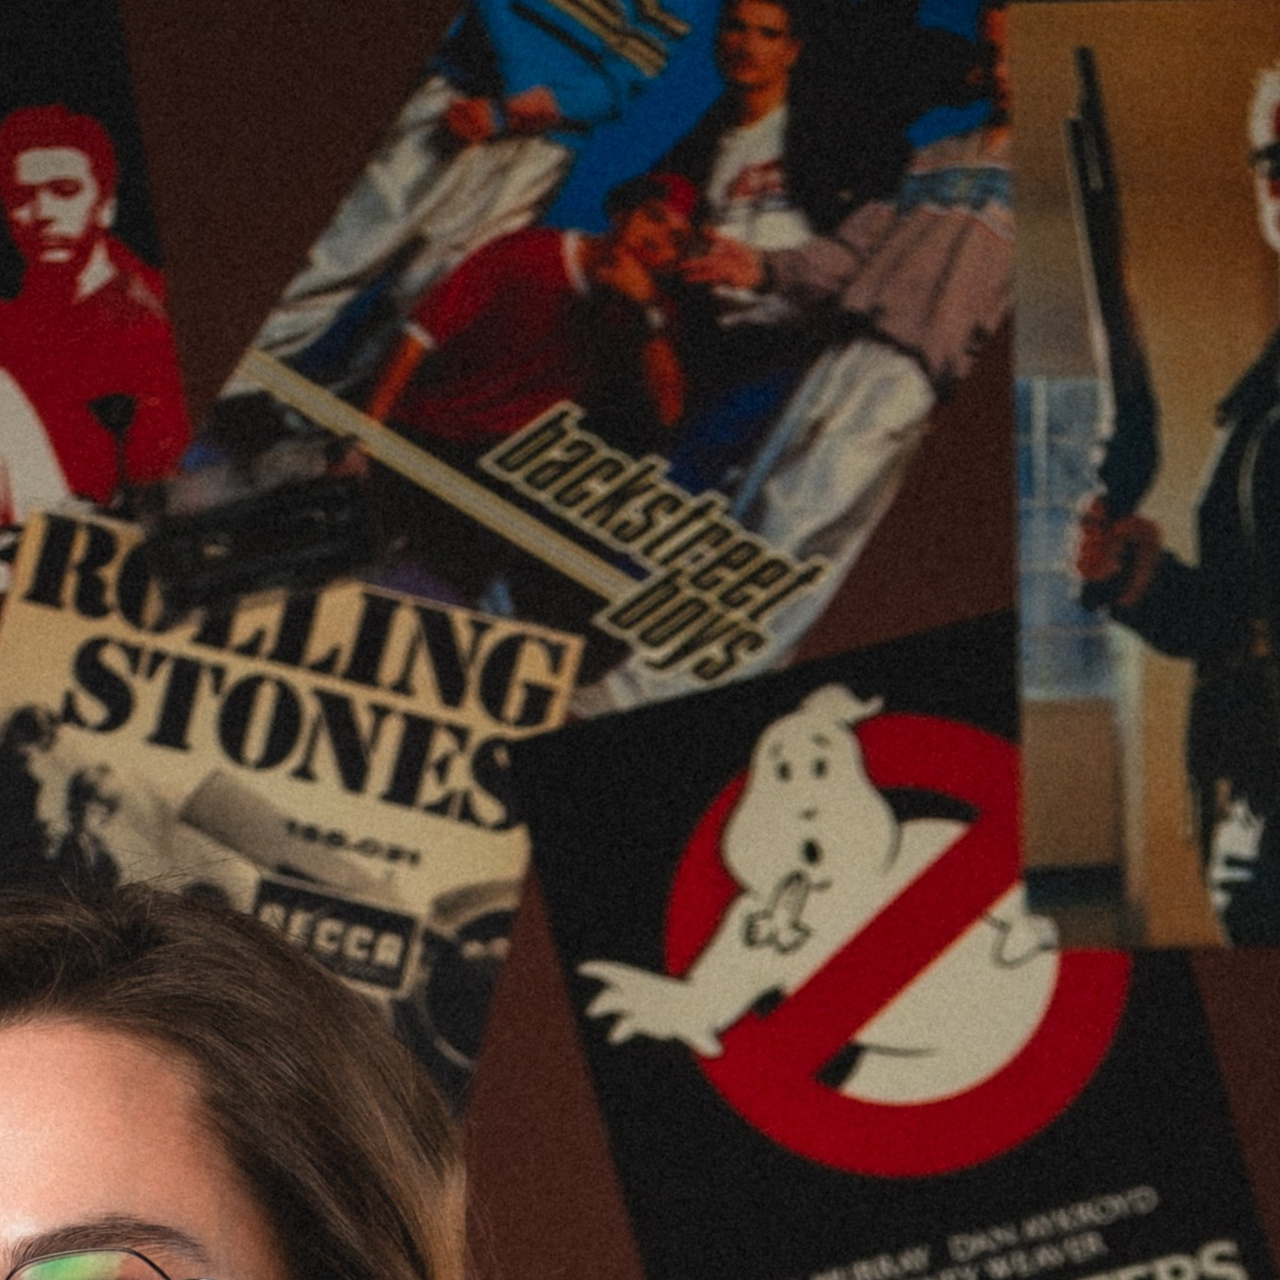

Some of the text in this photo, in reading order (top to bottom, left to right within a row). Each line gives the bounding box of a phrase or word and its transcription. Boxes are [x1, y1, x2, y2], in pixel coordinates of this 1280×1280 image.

[490, 404, 830, 625] backstreet
[606, 566, 766, 682] boys
[62, 634, 524, 832] STONES
[947, 1222, 1019, 1262] DAN
[1019, 1186, 1160, 1240] AYKROYD
